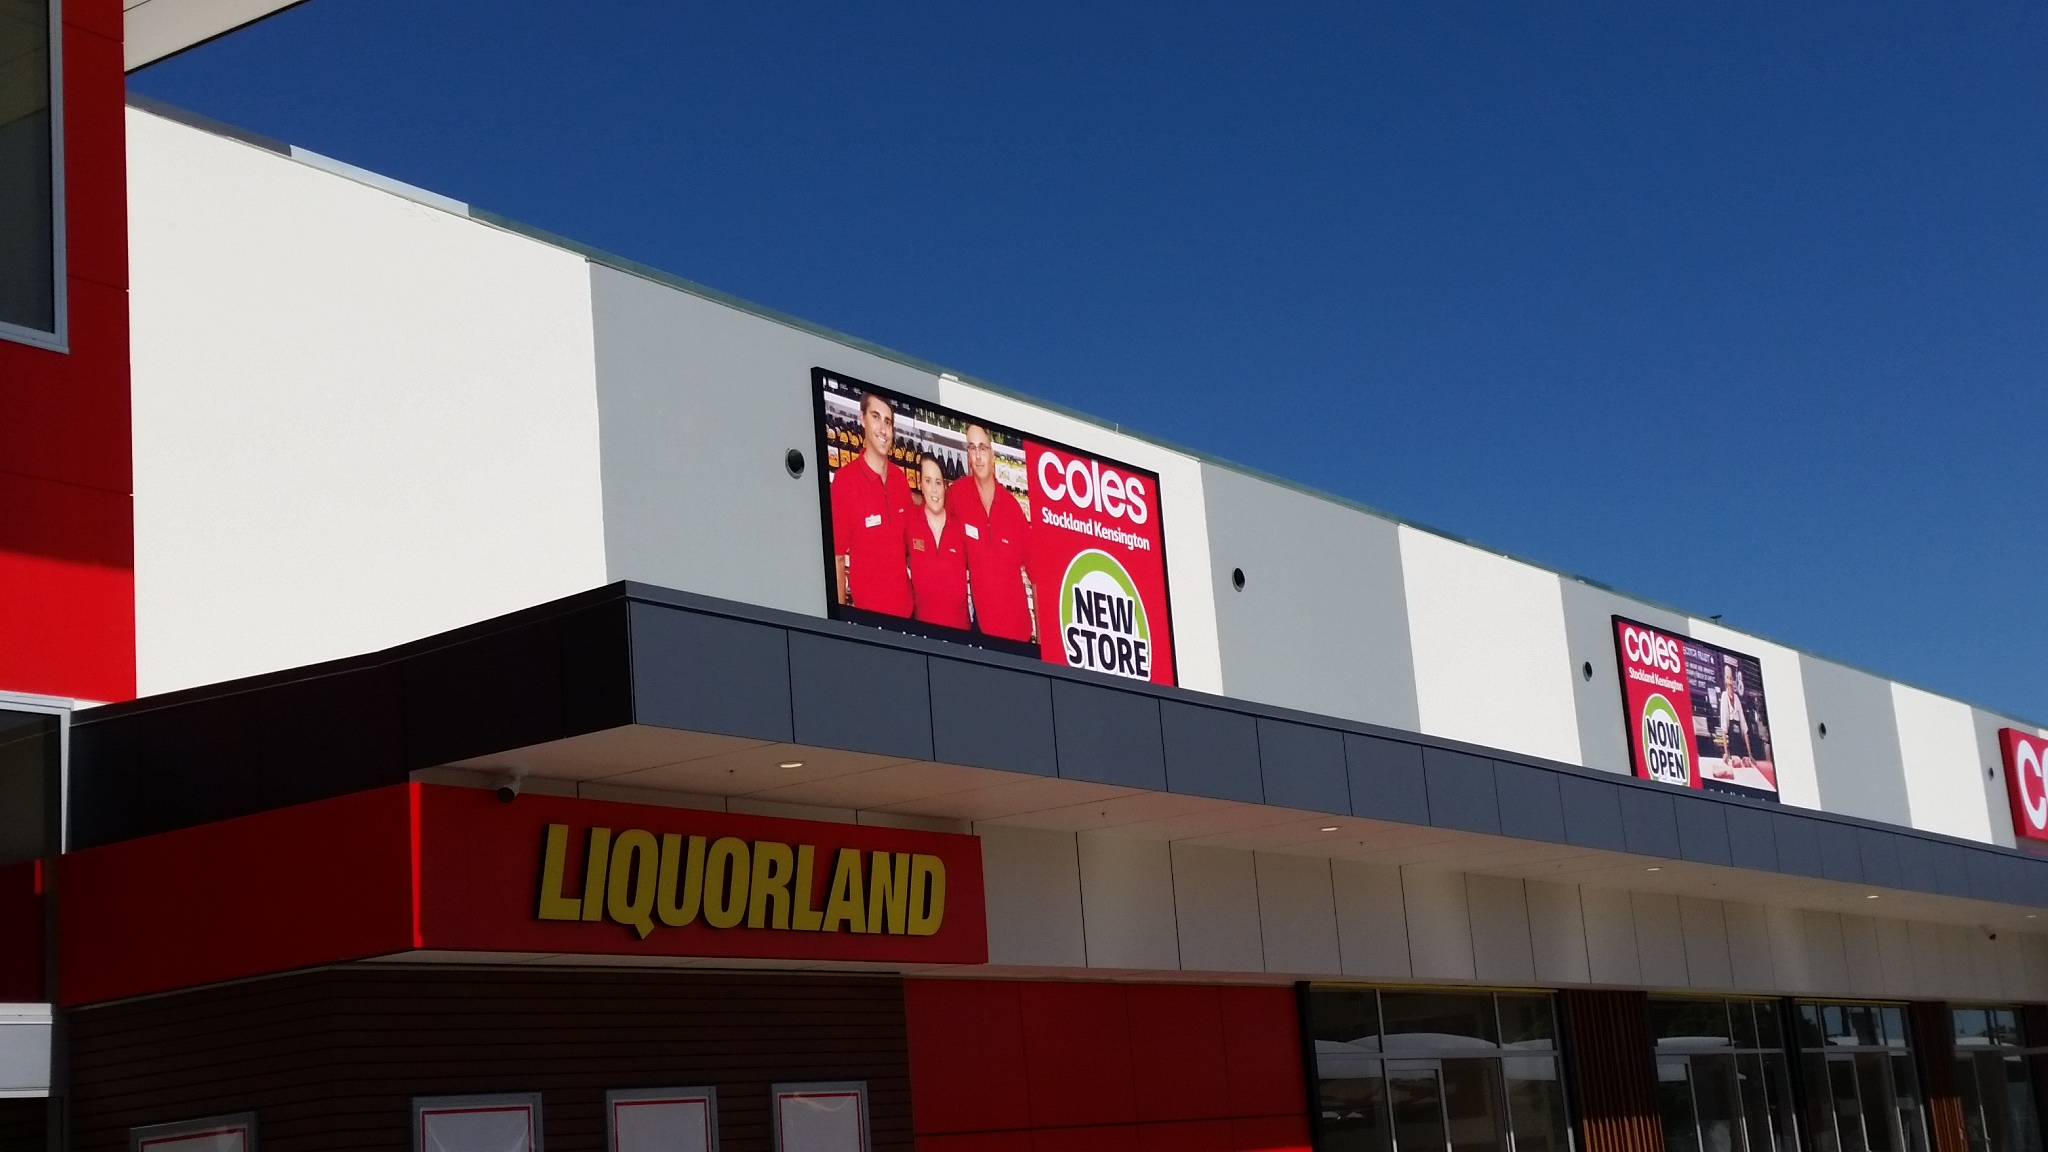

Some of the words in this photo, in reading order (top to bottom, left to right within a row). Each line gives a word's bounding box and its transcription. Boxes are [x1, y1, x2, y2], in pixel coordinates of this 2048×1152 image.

[1038, 451, 1148, 525] coles
[1041, 506, 1094, 536] Stockland
[1094, 520, 1151, 551] Kensington
[1074, 587, 1135, 635] NEW
[1067, 628, 1150, 678] STORE
[1624, 627, 1681, 674] coles
[1646, 718, 1681, 749] NOW
[1649, 747, 1686, 780] OPEN
[2016, 739, 2048, 830] c
[538, 823, 946, 940] LIQUORLAND
